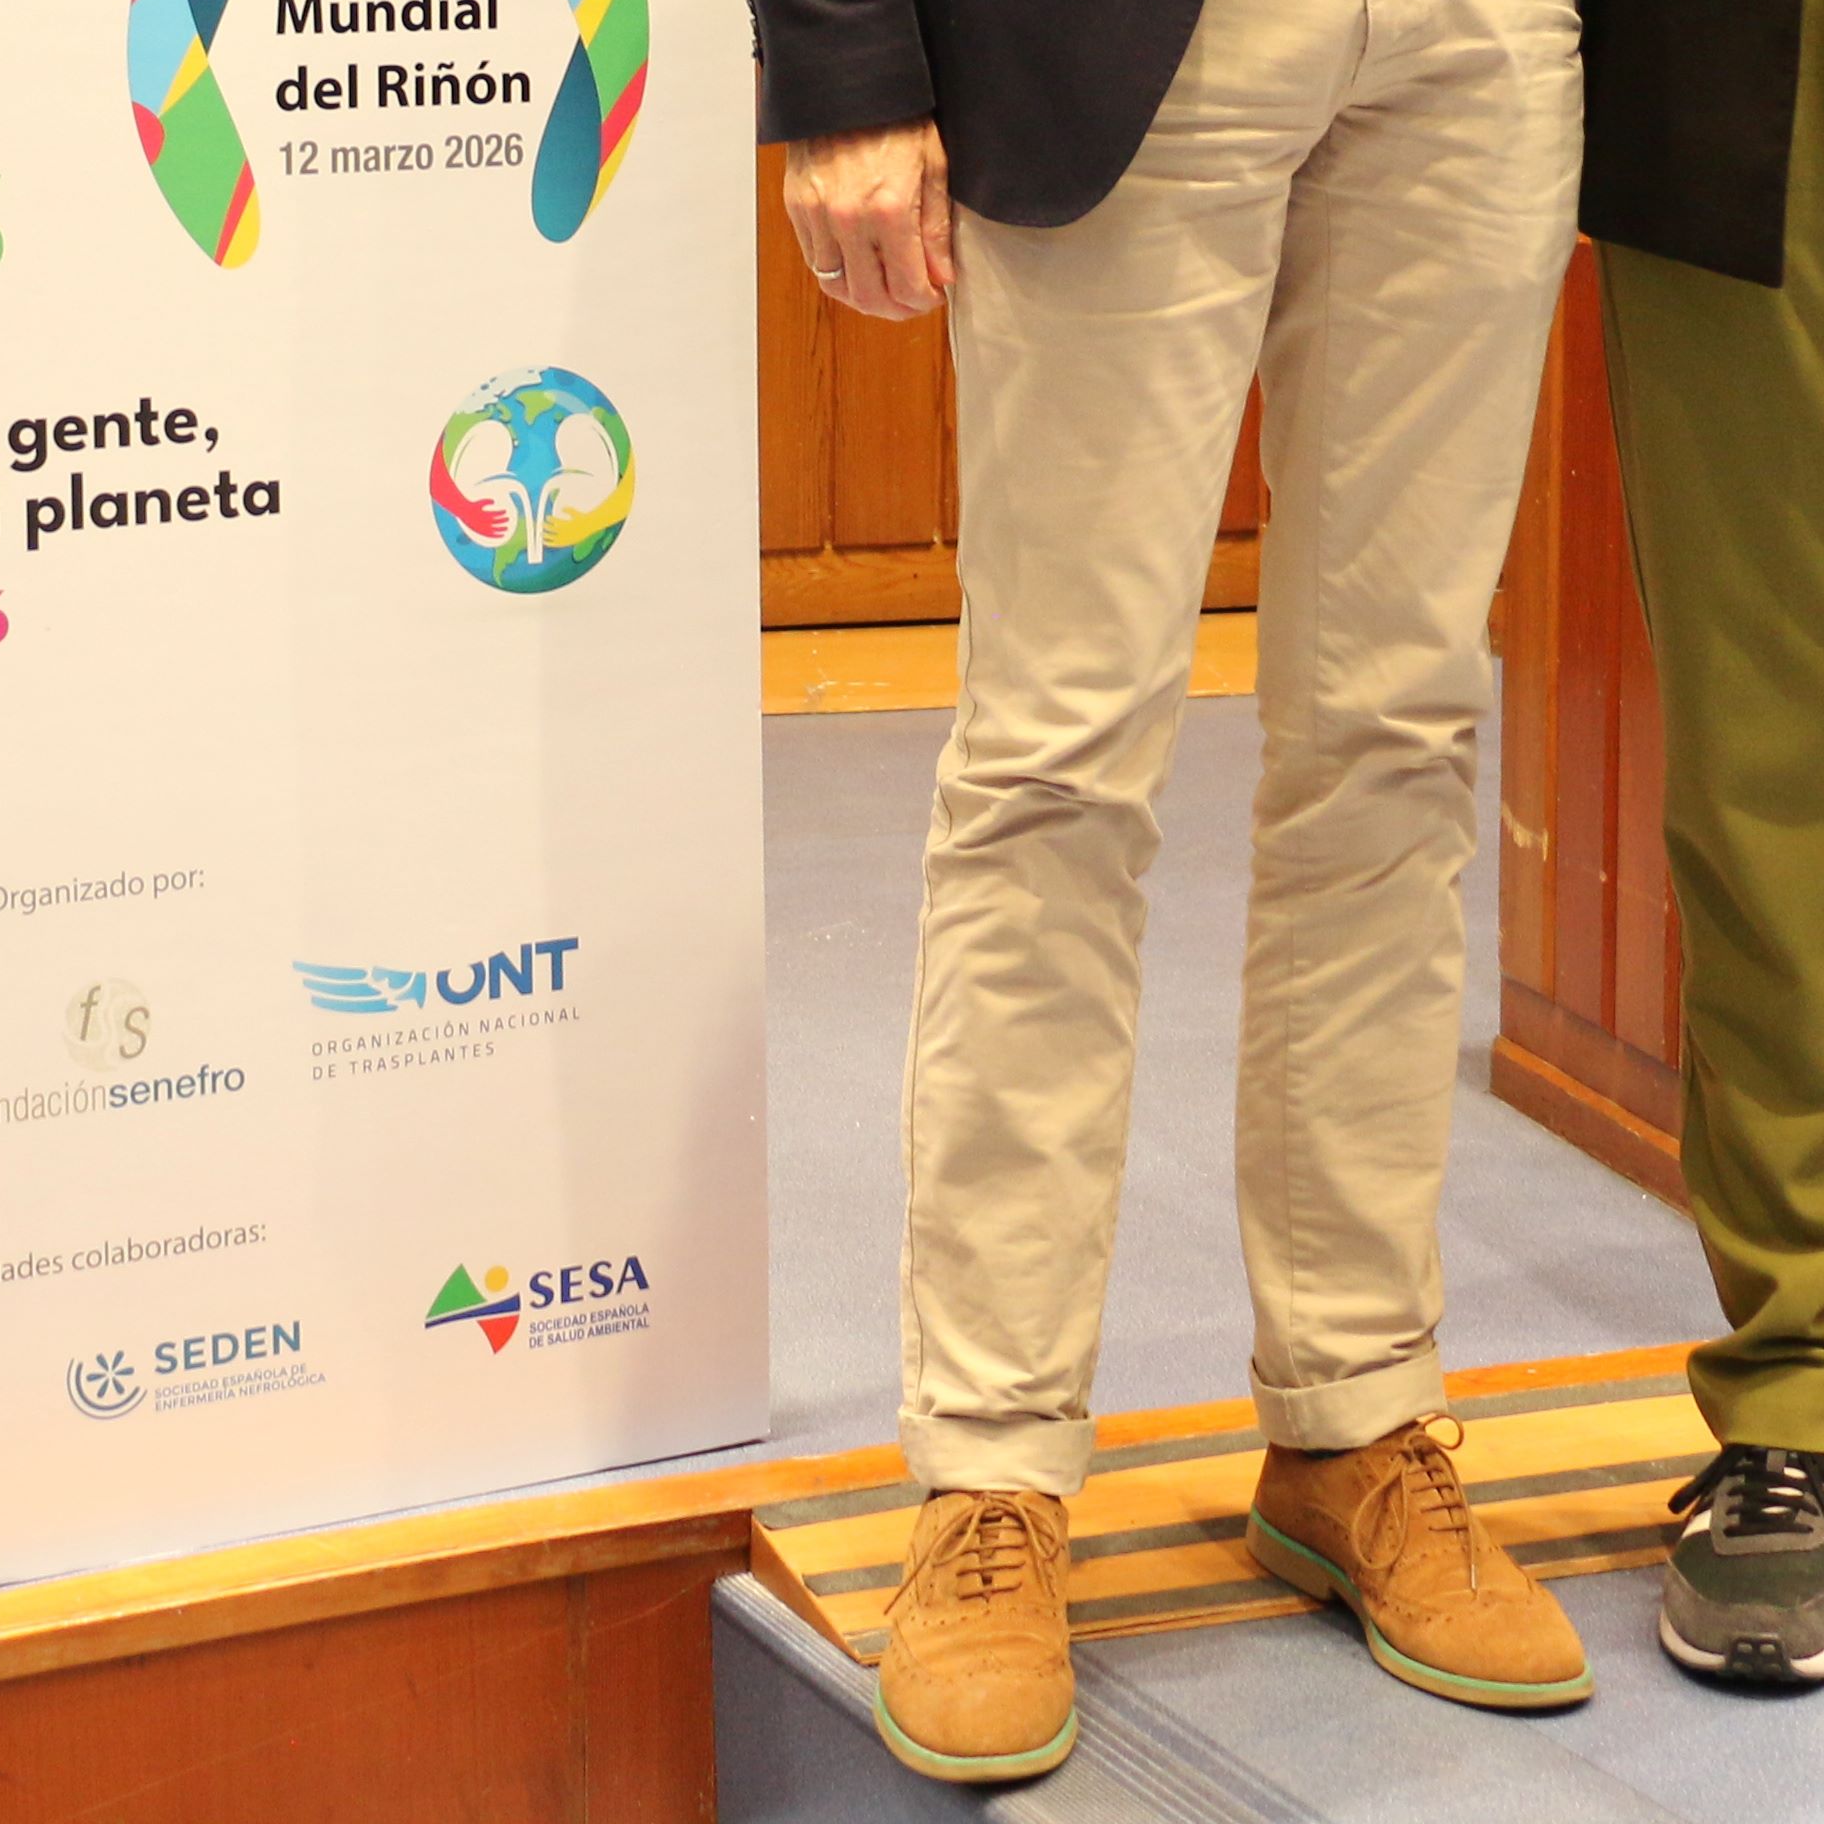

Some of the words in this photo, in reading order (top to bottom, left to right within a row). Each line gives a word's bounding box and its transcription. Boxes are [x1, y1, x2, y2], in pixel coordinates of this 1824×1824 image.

[275, 64, 358, 112] del
[378, 60, 531, 108] Riñón
[279, 140, 319, 175] 12
[330, 142, 434, 174] marzo
[445, 132, 524, 170] 2026
[7, 397, 221, 474] gente,
[25, 470, 283, 553] planeta
[153, 869, 205, 899] por:
[436, 936, 579, 1005] ONT
[312, 1020, 471, 1057] ORGANIZACIÓN
[479, 1006, 581, 1034] NACIONAL
[312, 1063, 337, 1081] DE
[350, 1041, 496, 1076] TRASPLANTES
[71, 1223, 267, 1271] colaboradoras:
[529, 1256, 649, 1309] SESA
[530, 1314, 587, 1334] SOCIEDAD
[590, 1303, 649, 1323] ESPAÑOLA
[530, 1336, 543, 1348] DE
[548, 1328, 585, 1345] SALUD
[588, 1318, 650, 1337] AMBIENTAL
[154, 1320, 301, 1375] SEDEN
[154, 1380, 218, 1399] SOCIEDAD
[291, 1363, 306, 1375] DE
[240, 1373, 326, 1396] NEFROLÓGICA
